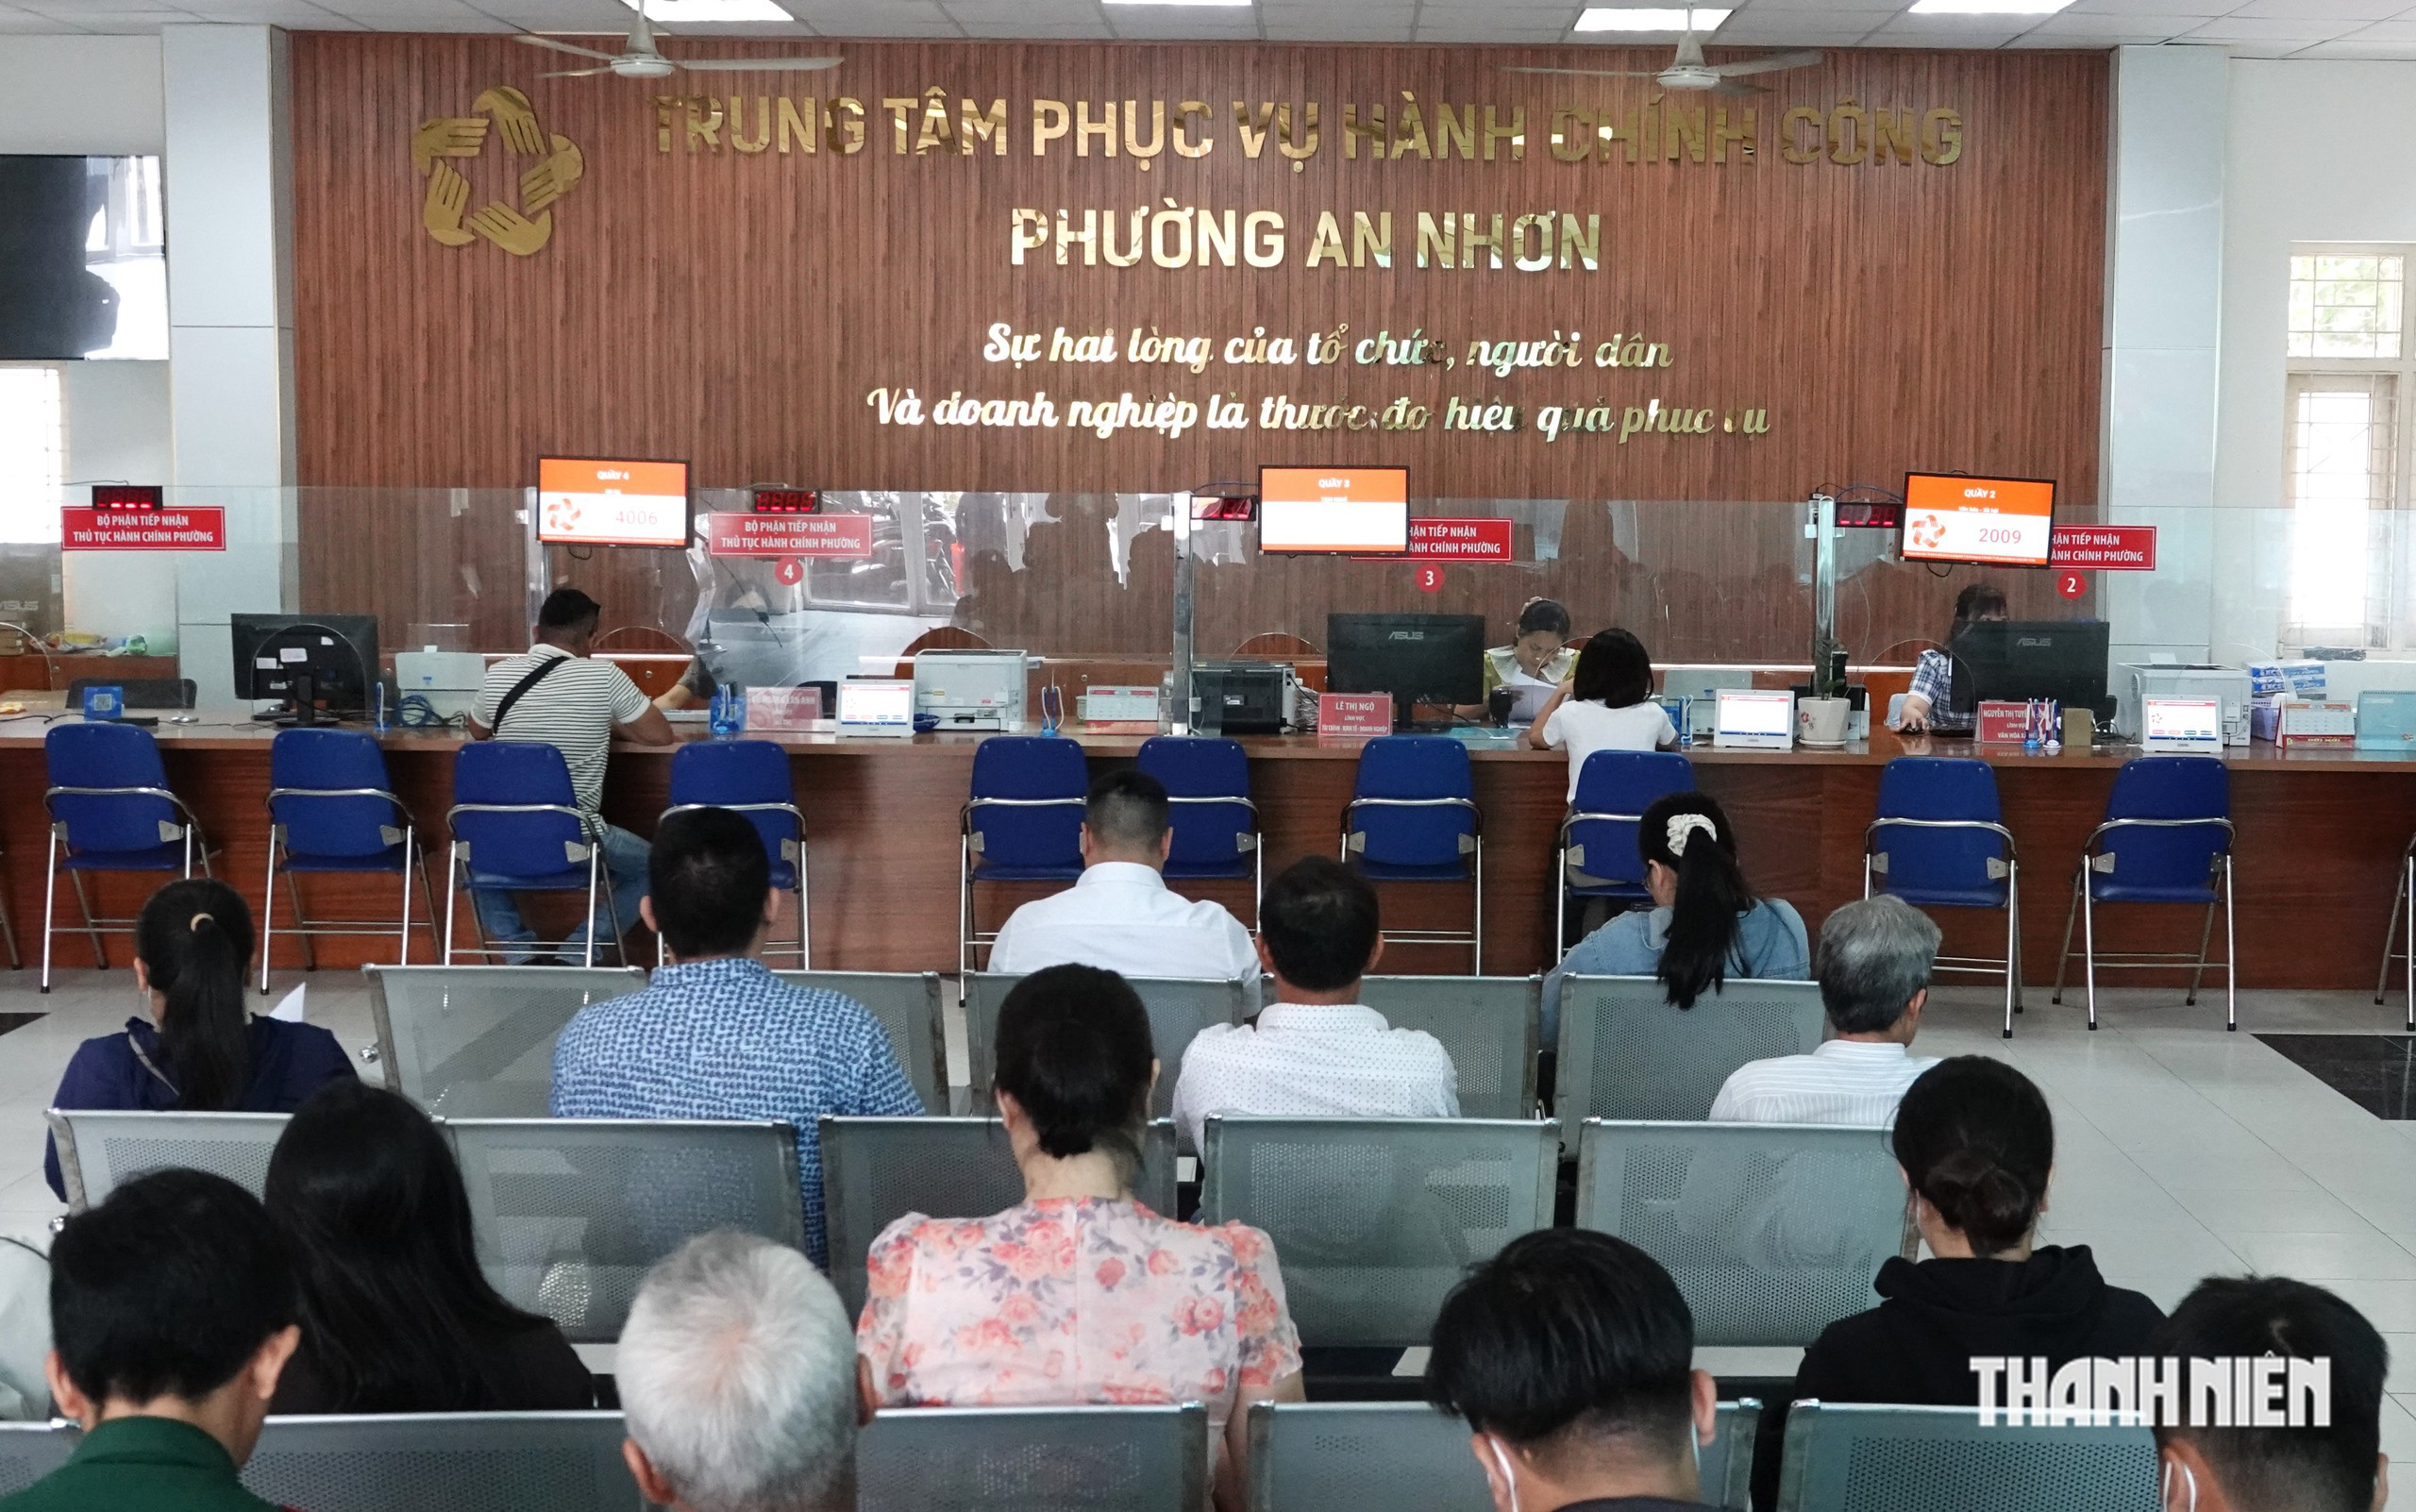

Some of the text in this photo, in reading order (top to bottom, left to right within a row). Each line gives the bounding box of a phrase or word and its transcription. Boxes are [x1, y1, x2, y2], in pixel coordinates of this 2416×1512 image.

[657, 86, 1963, 172] TRUNG TÂM PHỤC VỤ HÀNH CHÍNH CÔNG
[1010, 196, 1600, 272] PHƯỜNG AN NHƠN
[983, 322, 1041, 369] Sự
[1127, 326, 1213, 375] lòng
[1223, 327, 1298, 365] của
[1306, 323, 1350, 365] tổ
[1466, 329, 1584, 378] người
[1595, 331, 1674, 369] dân
[866, 386, 925, 426] Và
[932, 390, 1060, 428] doanh
[1066, 391, 1199, 440] nghiệp
[1205, 392, 1250, 430] là
[1381, 395, 1434, 431] đo
[1989, 490, 1996, 498] 2
[97, 512, 189, 529] BỘ PHẬN TIẾP NHẬN
[615, 510, 658, 526] 4006
[745, 518, 836, 536] BỘ PHẬN TIẾP NHẬN
[1409, 523, 1477, 540] HẬN TIẾP NHẬN
[73, 528, 213, 545] THỦ TỤC HÀNH CHÍNH PHƯỜNG
[721, 534, 861, 551] THỦ TỤC HÀNH CHÍNH PHƯỜNG
[1978, 528, 2022, 545] 2009
[2052, 531, 2120, 548] HẬN TIẾP NHẬN
[1408, 540, 1501, 554] ÀNH CHÍNH PHƯỜNG
[2051, 548, 2071, 562] ÀNH
[2072, 548, 2102, 562] CHÍNH
[2104, 549, 2143, 563] PHƯỜNG
[783, 563, 794, 580] 4
[1425, 570, 1434, 586] 3
[2066, 577, 2076, 593] 2
[1387, 630, 1424, 640] ASUS
[2016, 637, 2052, 647] ASUS
[1335, 700, 1375, 713] LÊ THỊ NGỘ
[2005, 710, 2015, 720] THỊ
